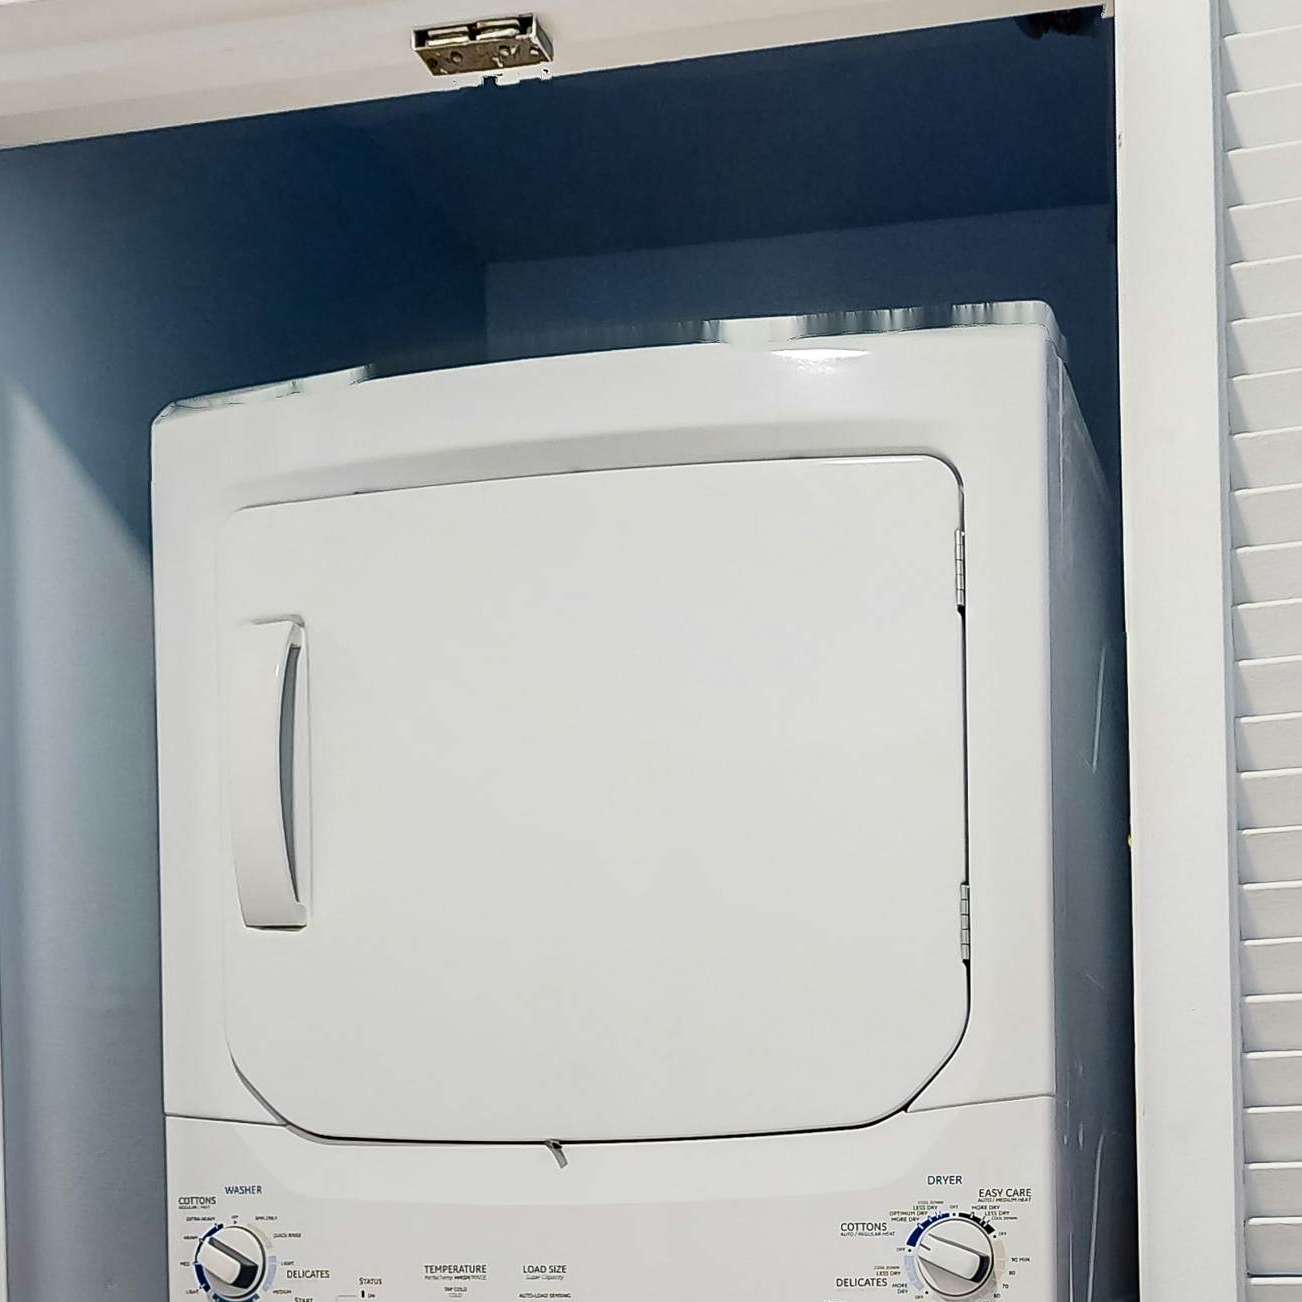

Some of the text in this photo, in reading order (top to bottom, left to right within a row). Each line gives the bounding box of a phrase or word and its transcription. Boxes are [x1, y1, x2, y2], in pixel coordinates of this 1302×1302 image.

[927, 1175, 963, 1185] DRYER
[224, 1185, 262, 1195] WASHER
[978, 1188, 1032, 1197] EASY CARE
[178, 1196, 217, 1205] COTTONS
[840, 1222, 887, 1231] COTTONS
[287, 1270, 330, 1278] DELICATES
[424, 1265, 487, 1274] TEMPERATURE
[523, 1265, 567, 1274] LOAD SIZE
[359, 1277, 382, 1285] STATUS
[836, 1278, 888, 1287] DELICATES
